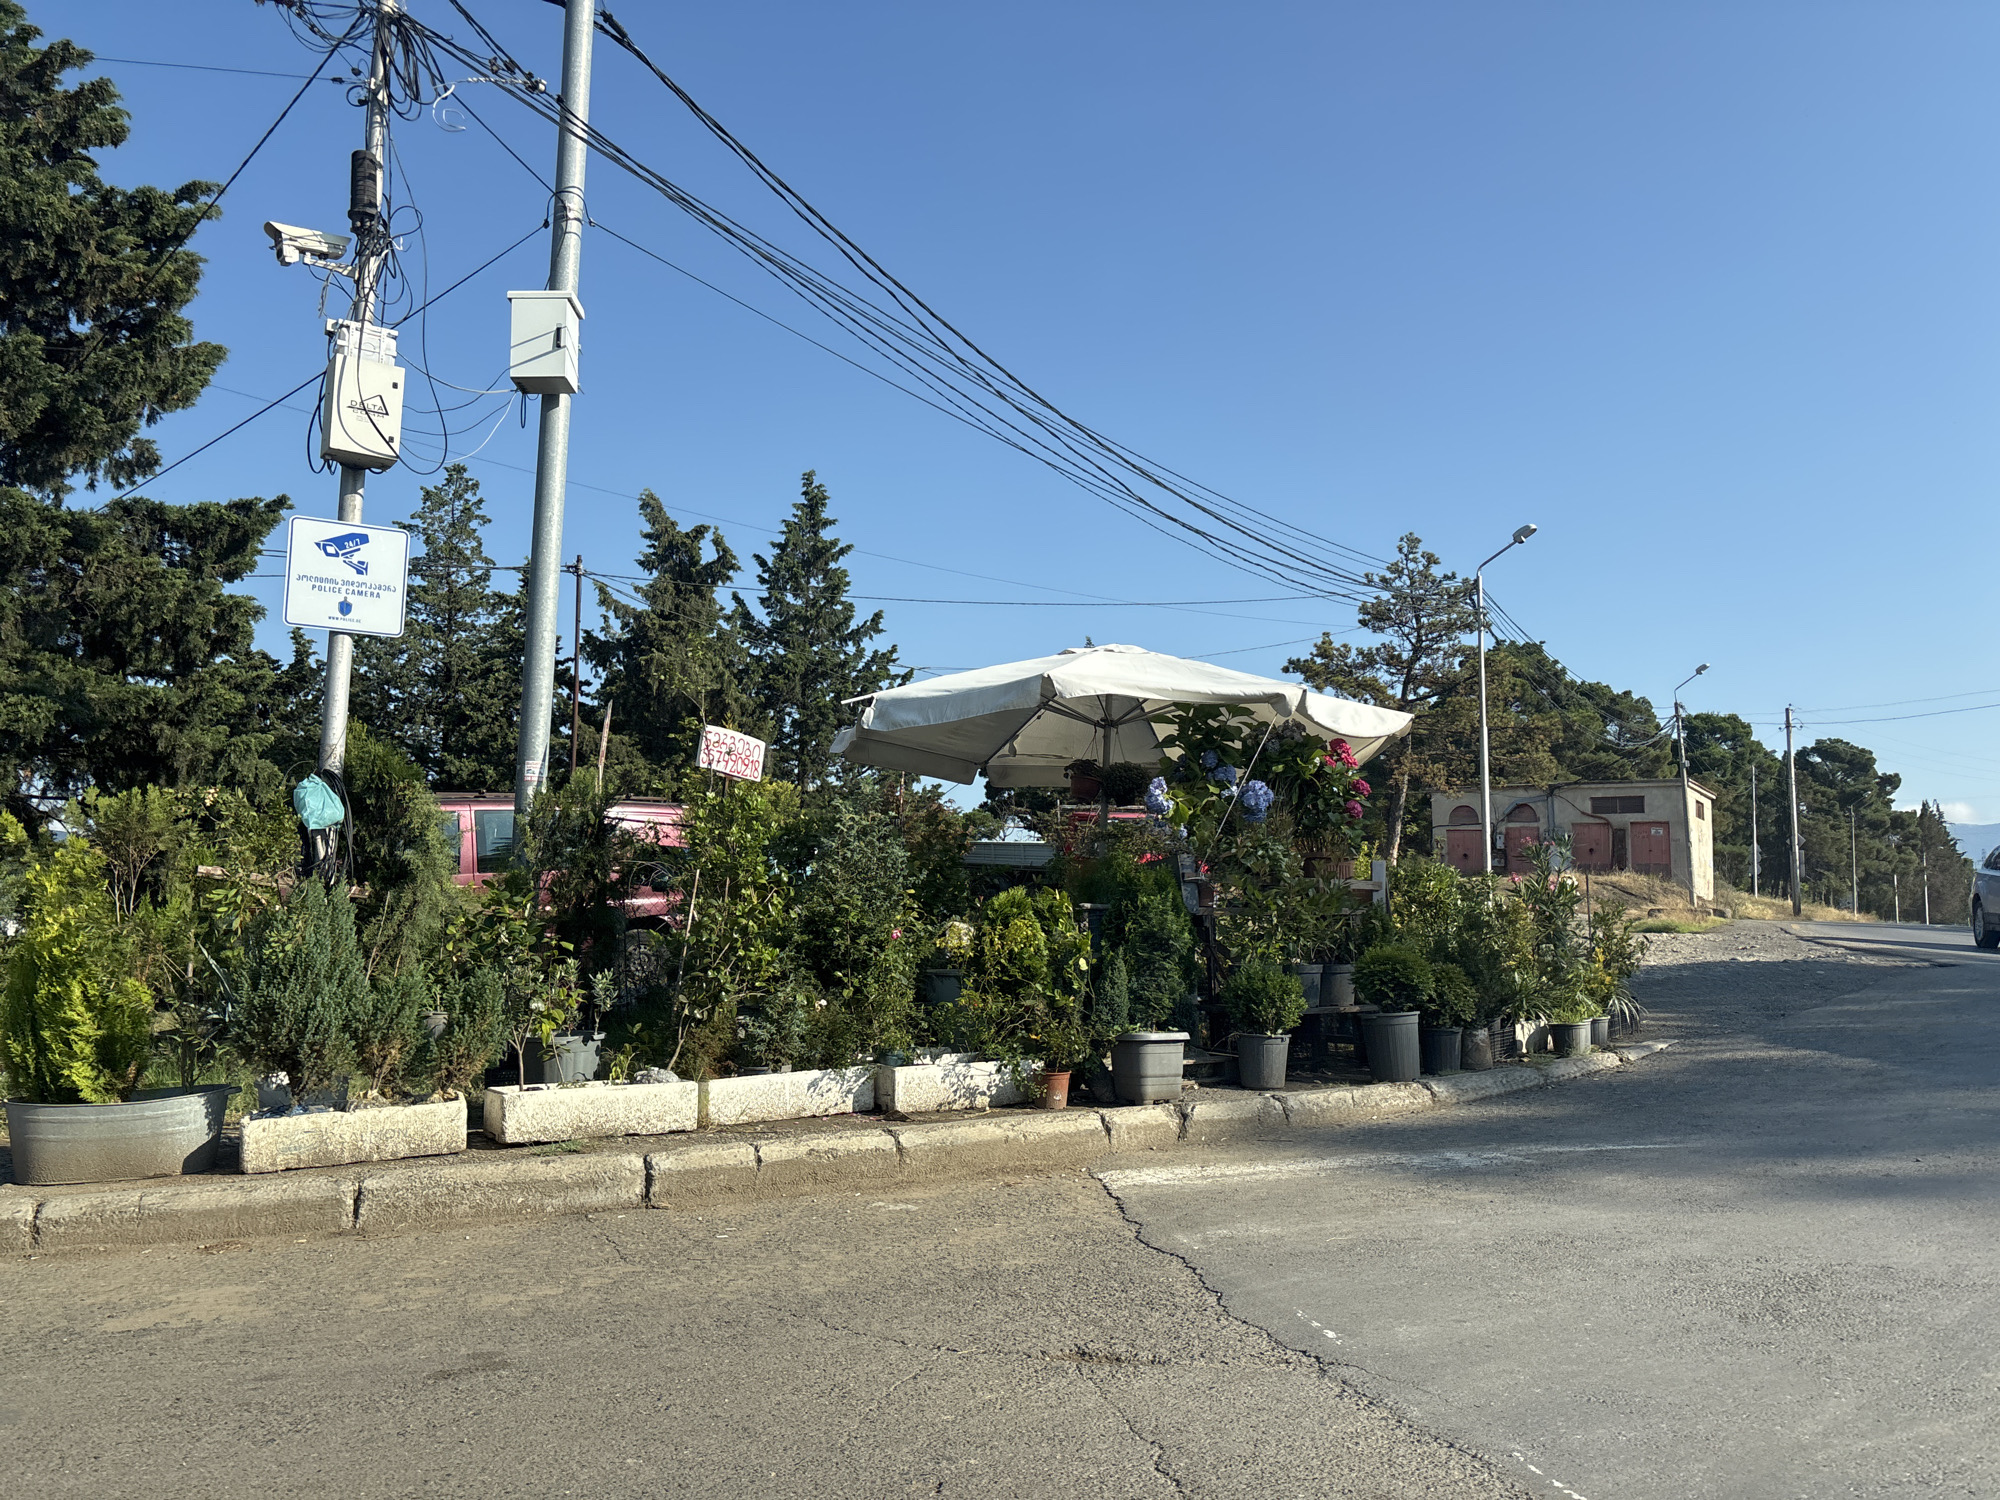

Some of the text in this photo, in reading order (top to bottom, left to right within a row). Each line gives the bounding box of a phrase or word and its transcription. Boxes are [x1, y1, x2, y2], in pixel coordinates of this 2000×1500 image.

[350, 400, 383, 411] DELTA
[344, 538, 360, 549] 24/7
[296, 574, 397, 593] პოლიციის ვიდეოკამერა
[312, 584, 381, 599] POLICE CAMERA
